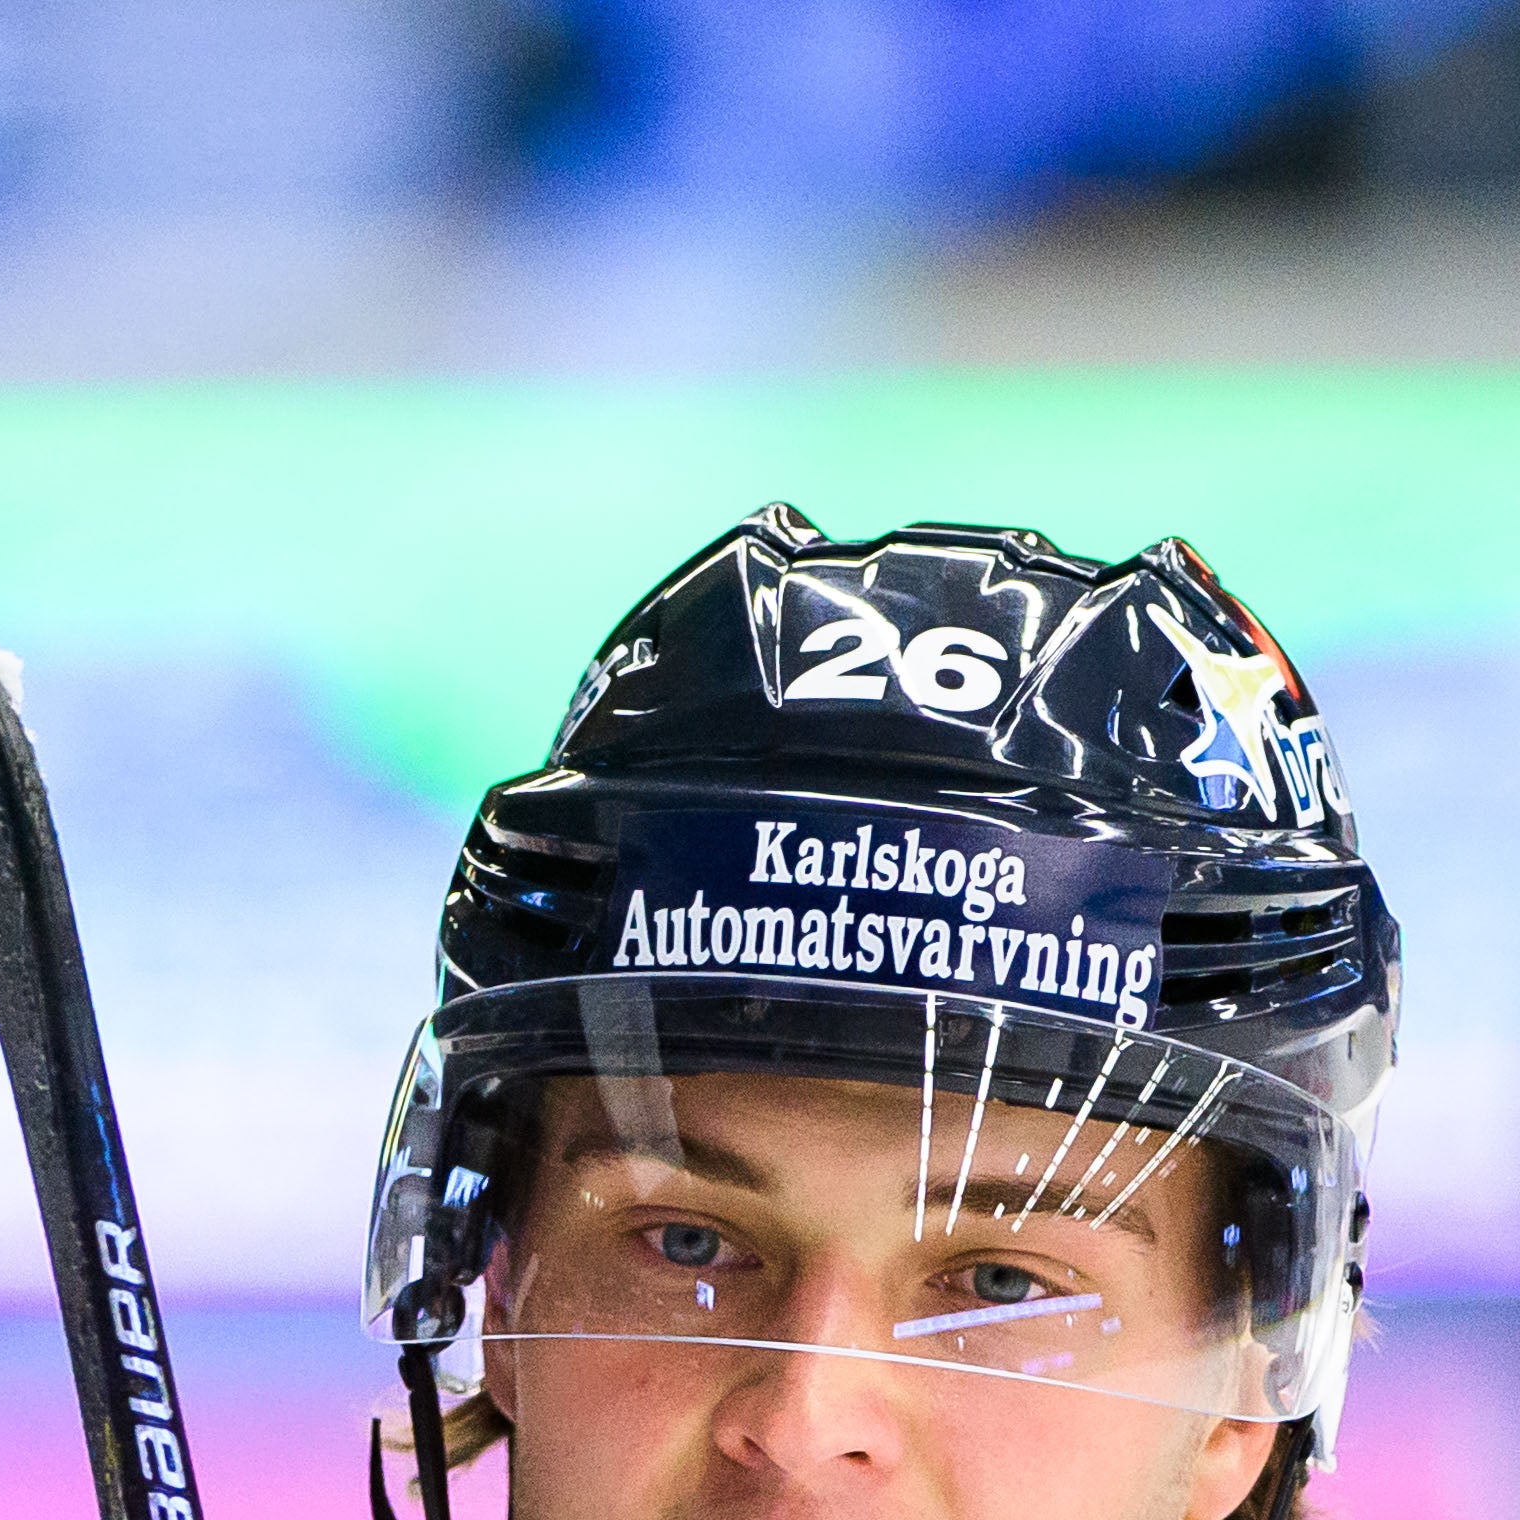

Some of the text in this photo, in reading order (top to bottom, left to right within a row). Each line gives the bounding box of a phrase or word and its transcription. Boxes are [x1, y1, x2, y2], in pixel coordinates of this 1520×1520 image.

[782, 617, 1009, 713] 26
[749, 821, 1026, 922] Karlskoga
[613, 889, 1157, 1031] Automatsvarvning
